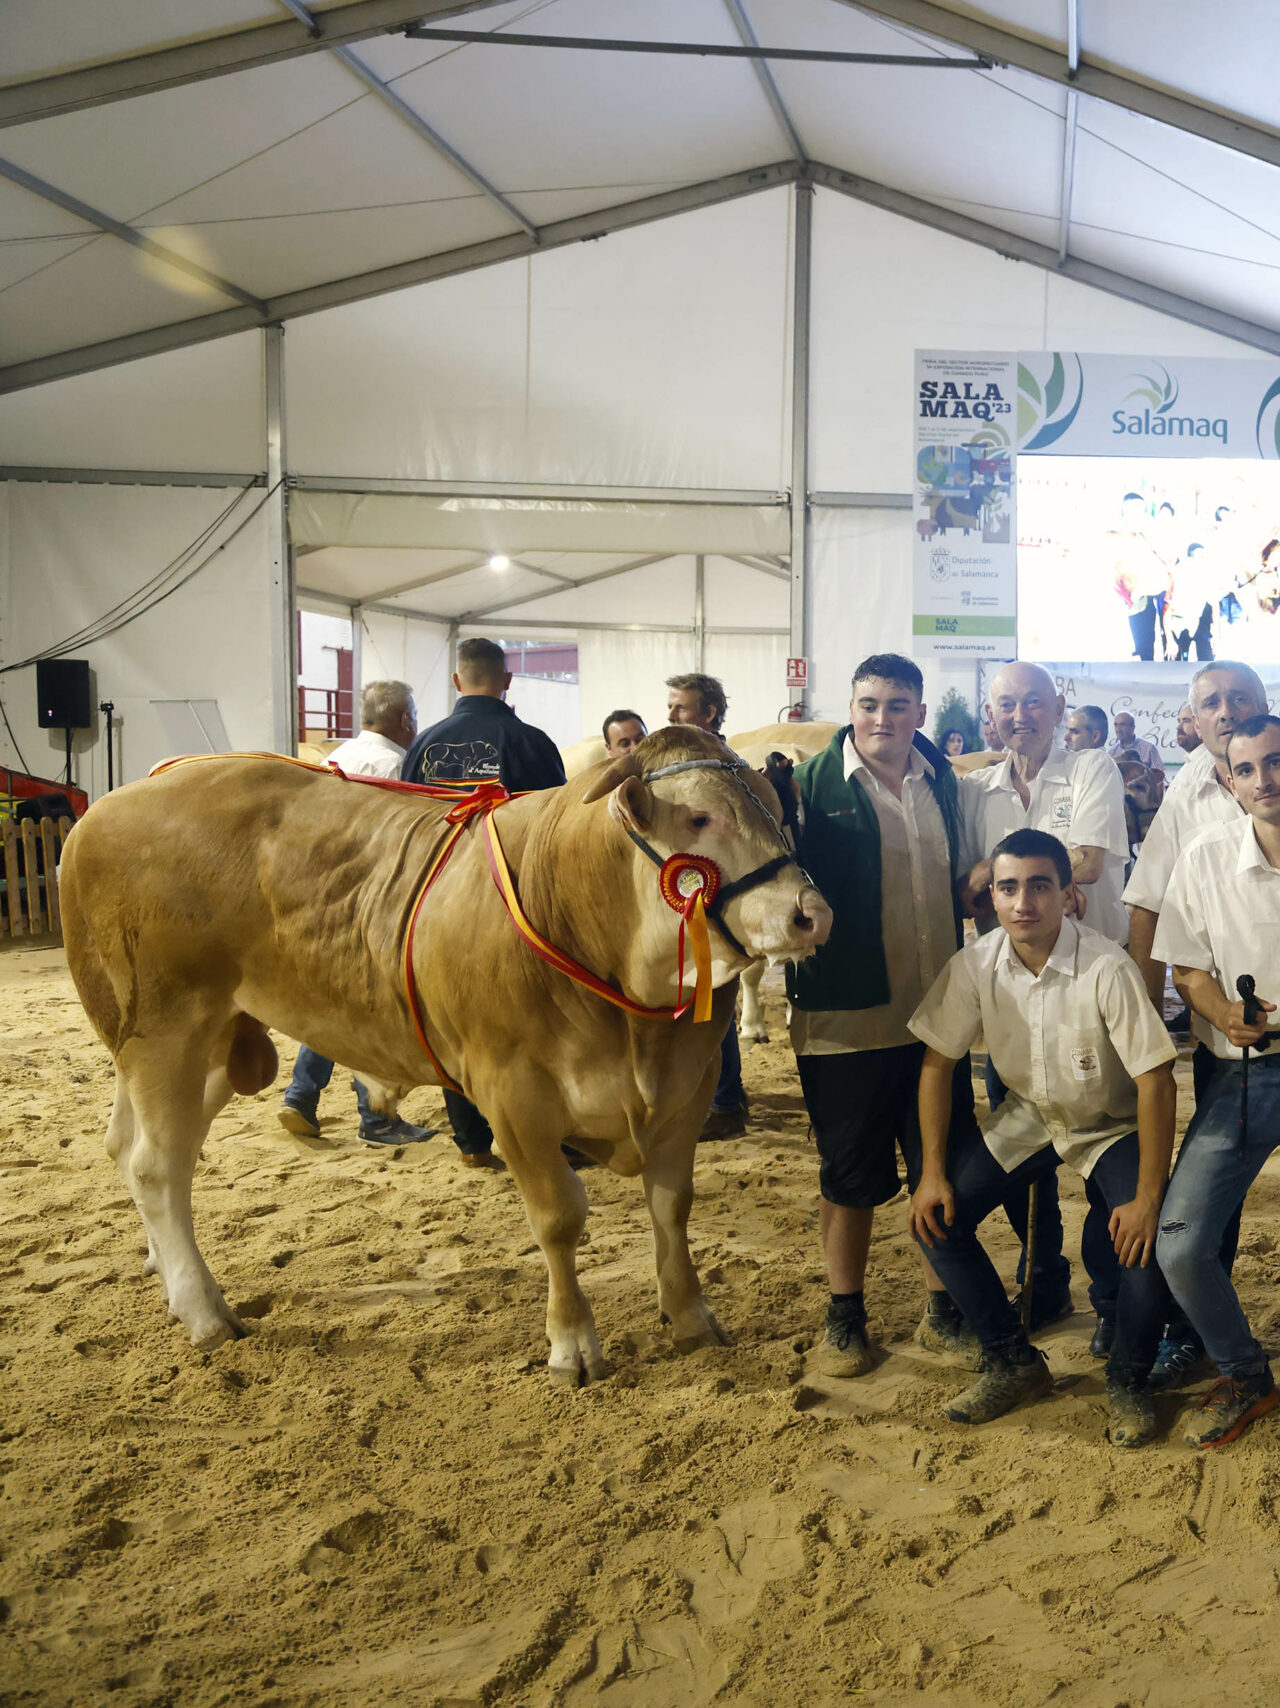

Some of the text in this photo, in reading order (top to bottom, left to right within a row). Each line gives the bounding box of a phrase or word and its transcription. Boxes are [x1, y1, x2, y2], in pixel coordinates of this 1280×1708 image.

[919, 380, 1004, 400] SALA
[919, 399, 995, 422] MAQ
[1112, 408, 1228, 444] Salamaq
[961, 570, 999, 579] Salamanca
[933, 642, 996, 651] www.salamaq.es
